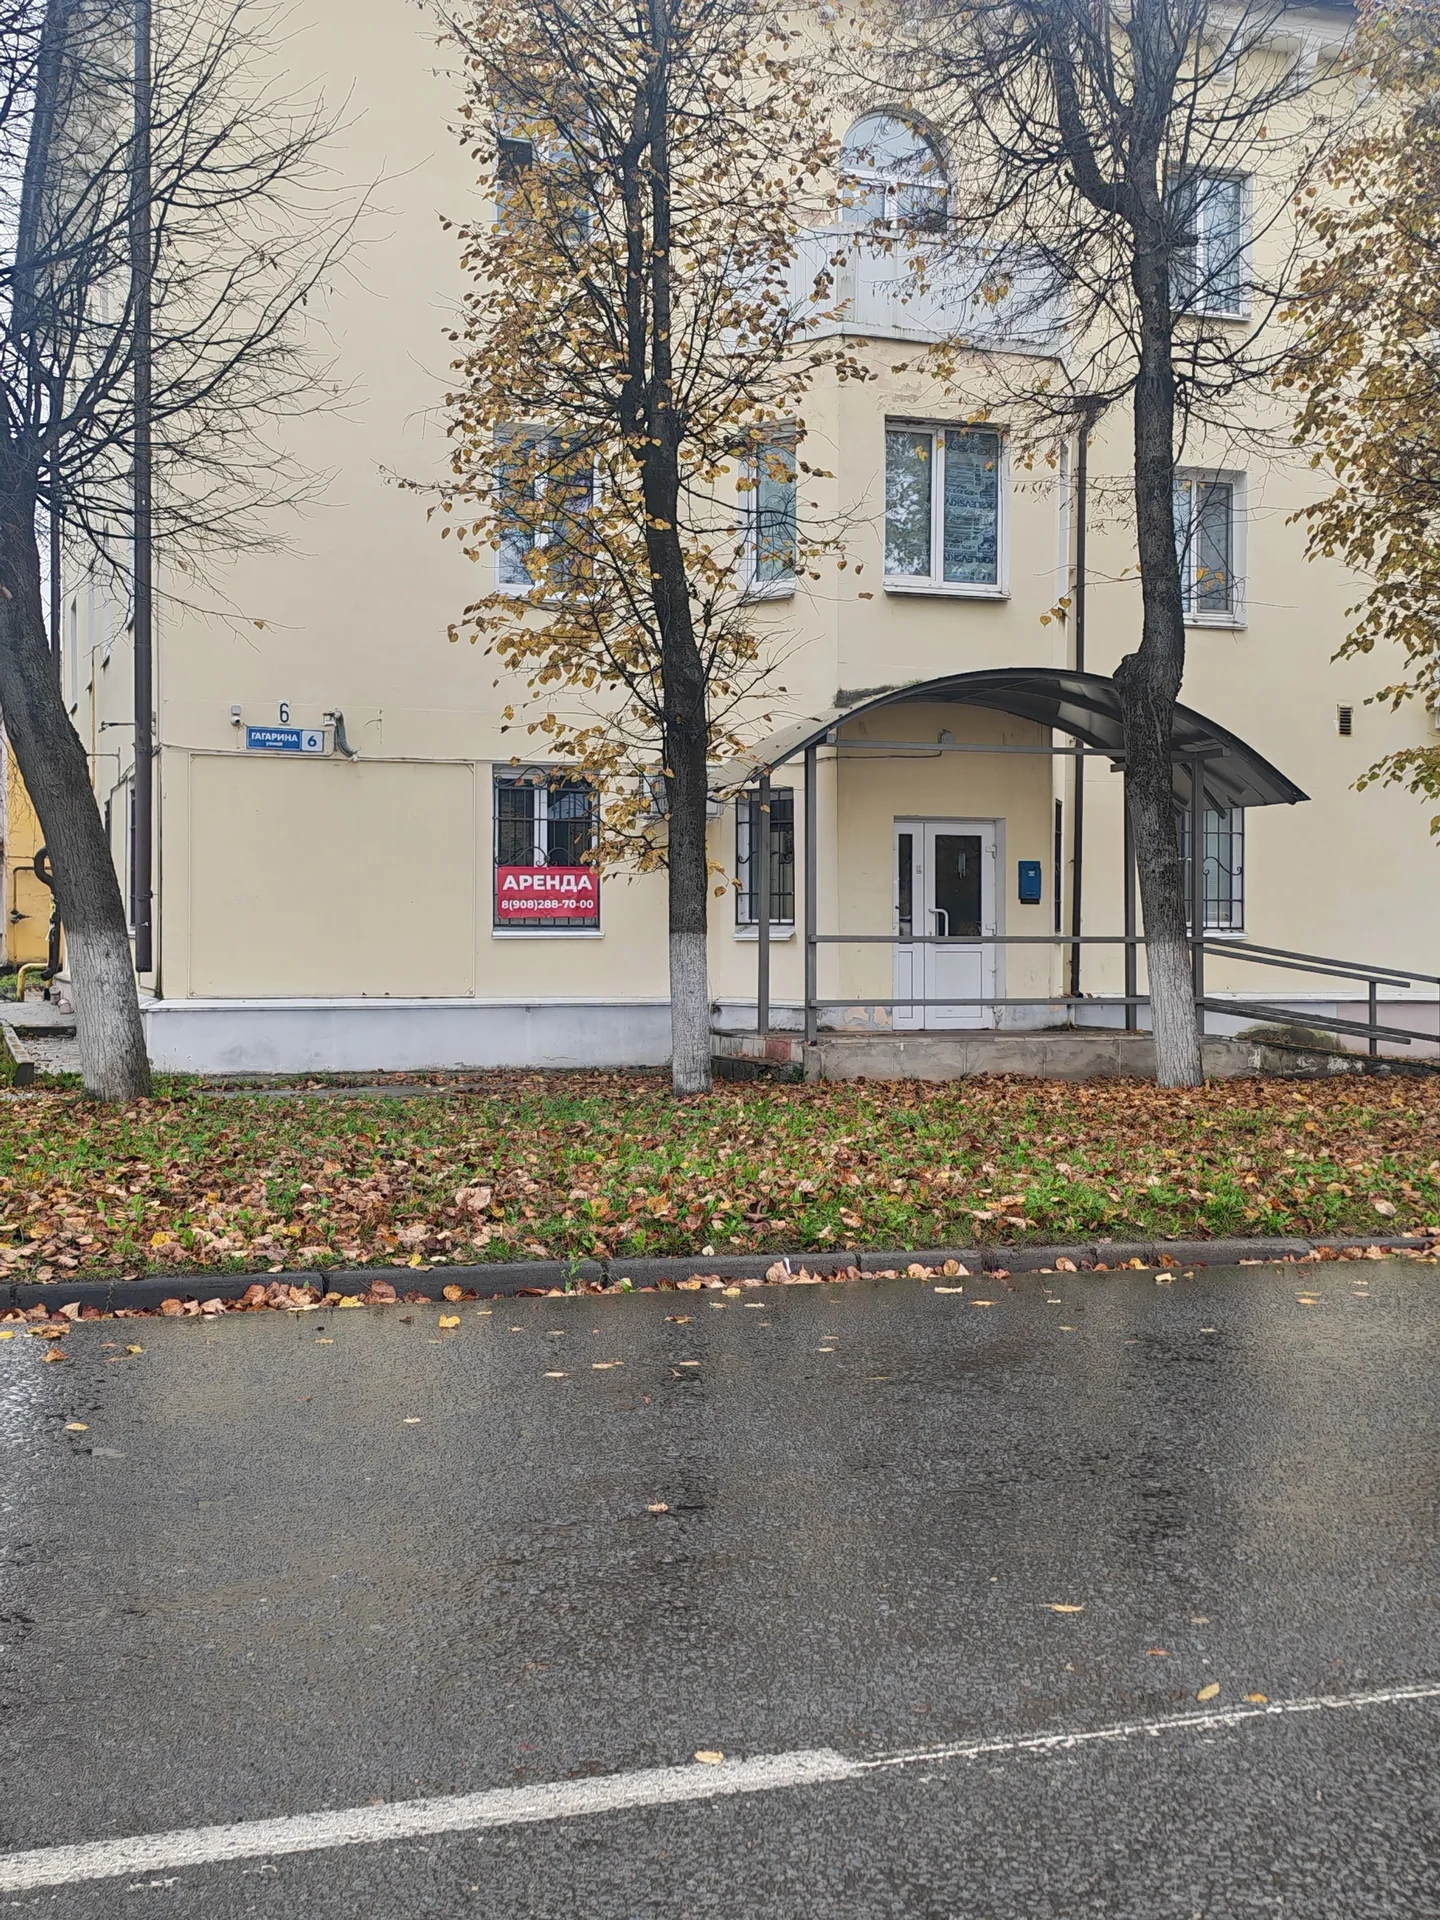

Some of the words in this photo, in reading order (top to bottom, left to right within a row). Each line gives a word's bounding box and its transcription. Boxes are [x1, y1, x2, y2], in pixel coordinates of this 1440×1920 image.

[279, 702, 289, 723] 6
[251, 732, 298, 742] ГАГАРИНА
[307, 735, 317, 747] 6
[502, 875, 593, 893] АРЕНДА
[501, 899, 594, 911] 8(908)288-70-00
